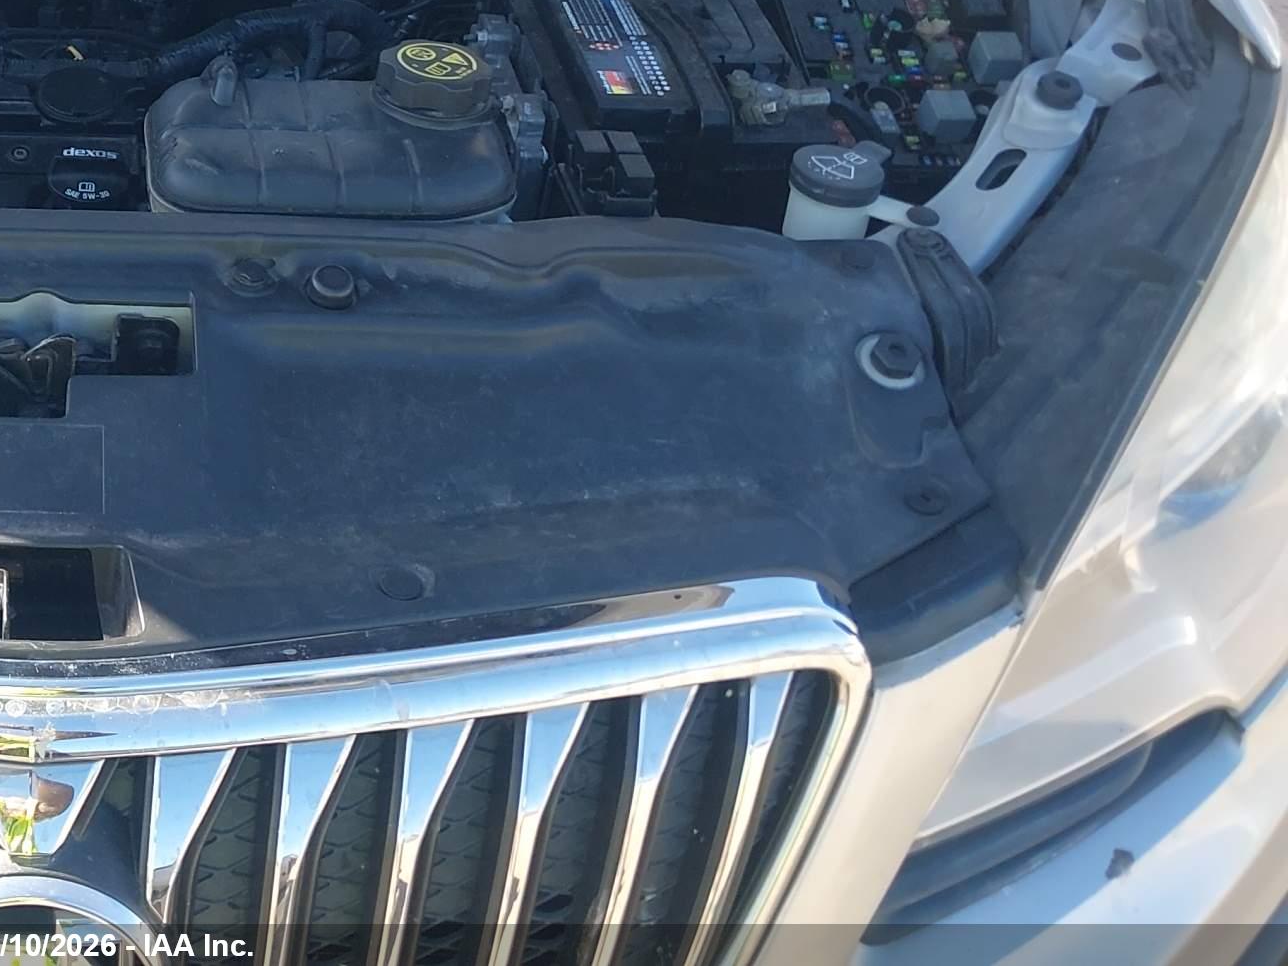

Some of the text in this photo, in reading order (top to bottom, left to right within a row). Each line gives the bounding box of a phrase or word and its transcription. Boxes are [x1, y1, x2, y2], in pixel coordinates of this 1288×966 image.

[62, 147, 120, 160] dexos
[64, 188, 111, 200] SAE 5W-30
